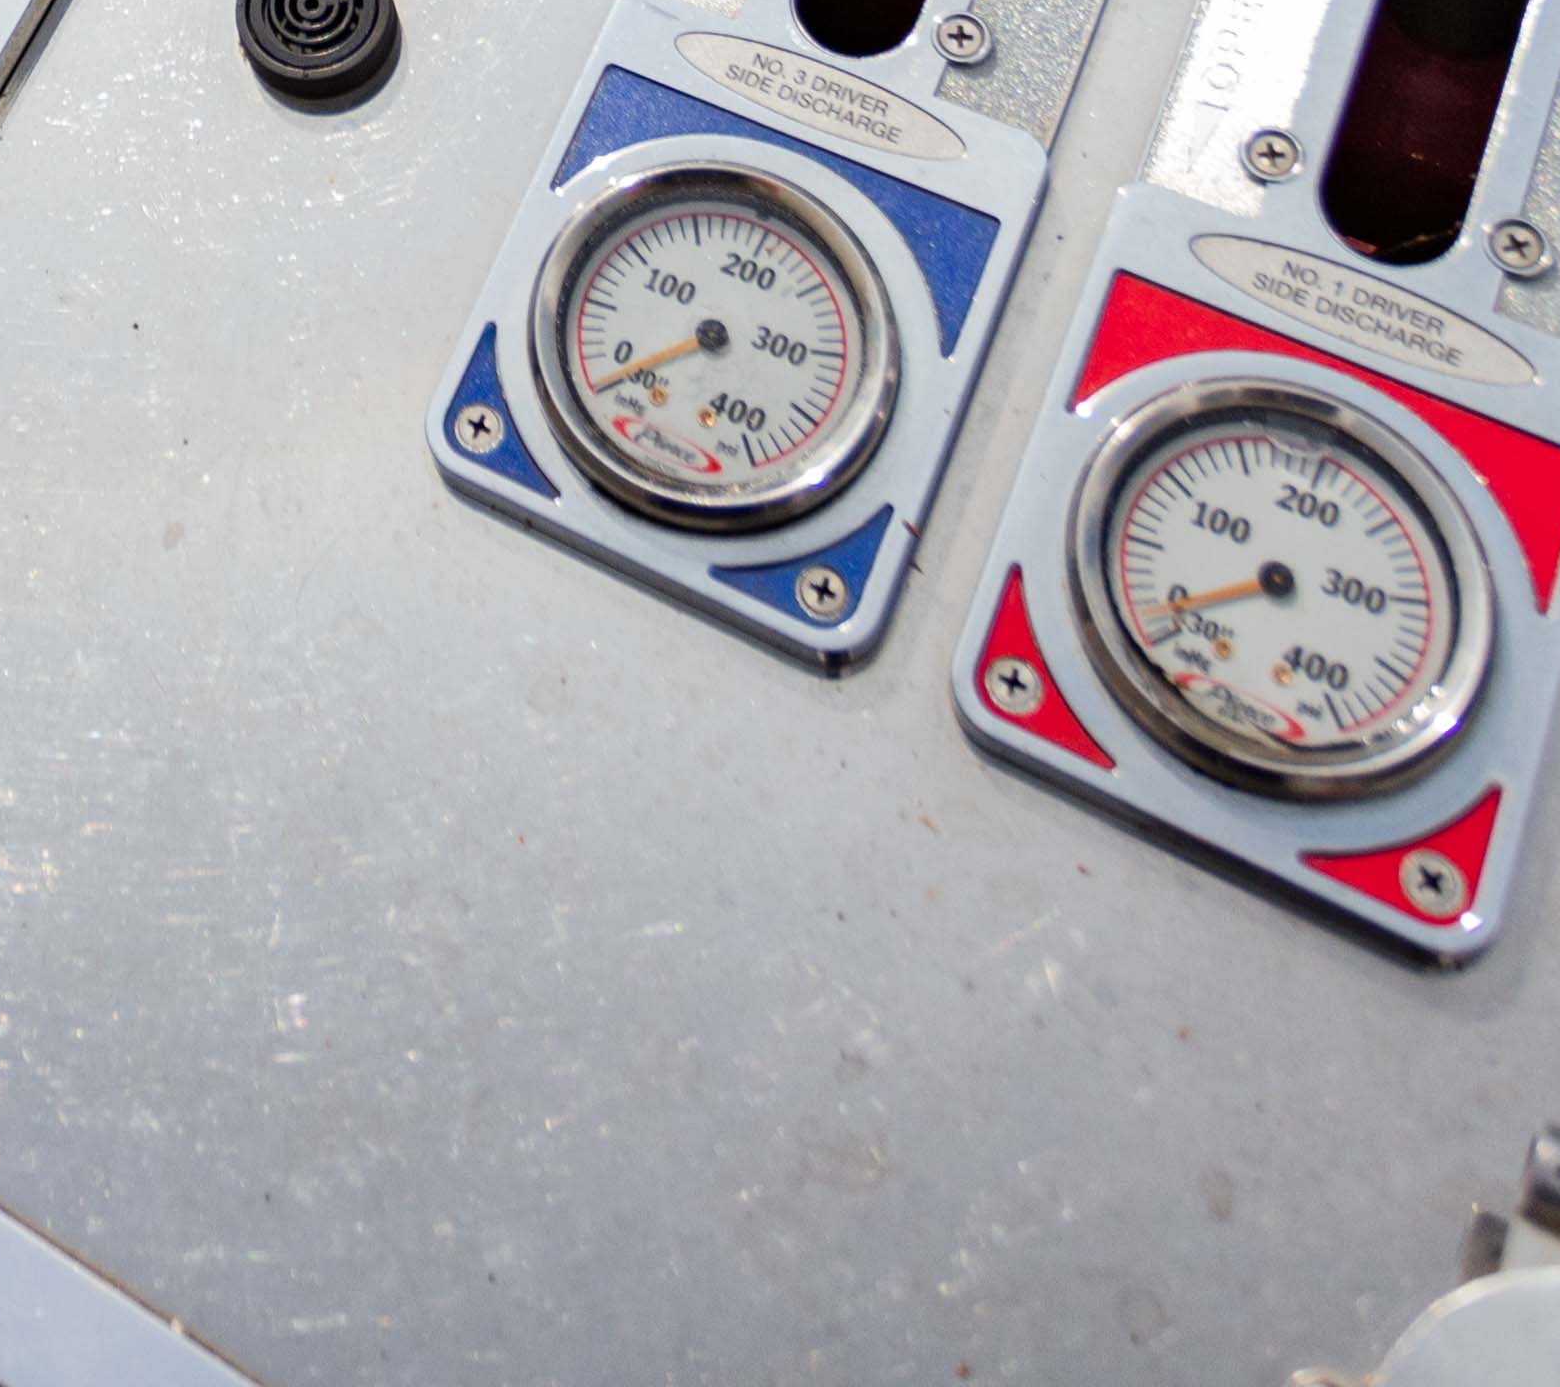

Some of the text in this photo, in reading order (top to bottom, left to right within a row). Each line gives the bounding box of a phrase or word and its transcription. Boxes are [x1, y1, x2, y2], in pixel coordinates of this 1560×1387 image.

[725, 65, 903, 144] SIDE DISCHARGE
[753, 53, 889, 117] NO. 3 DRIVER
